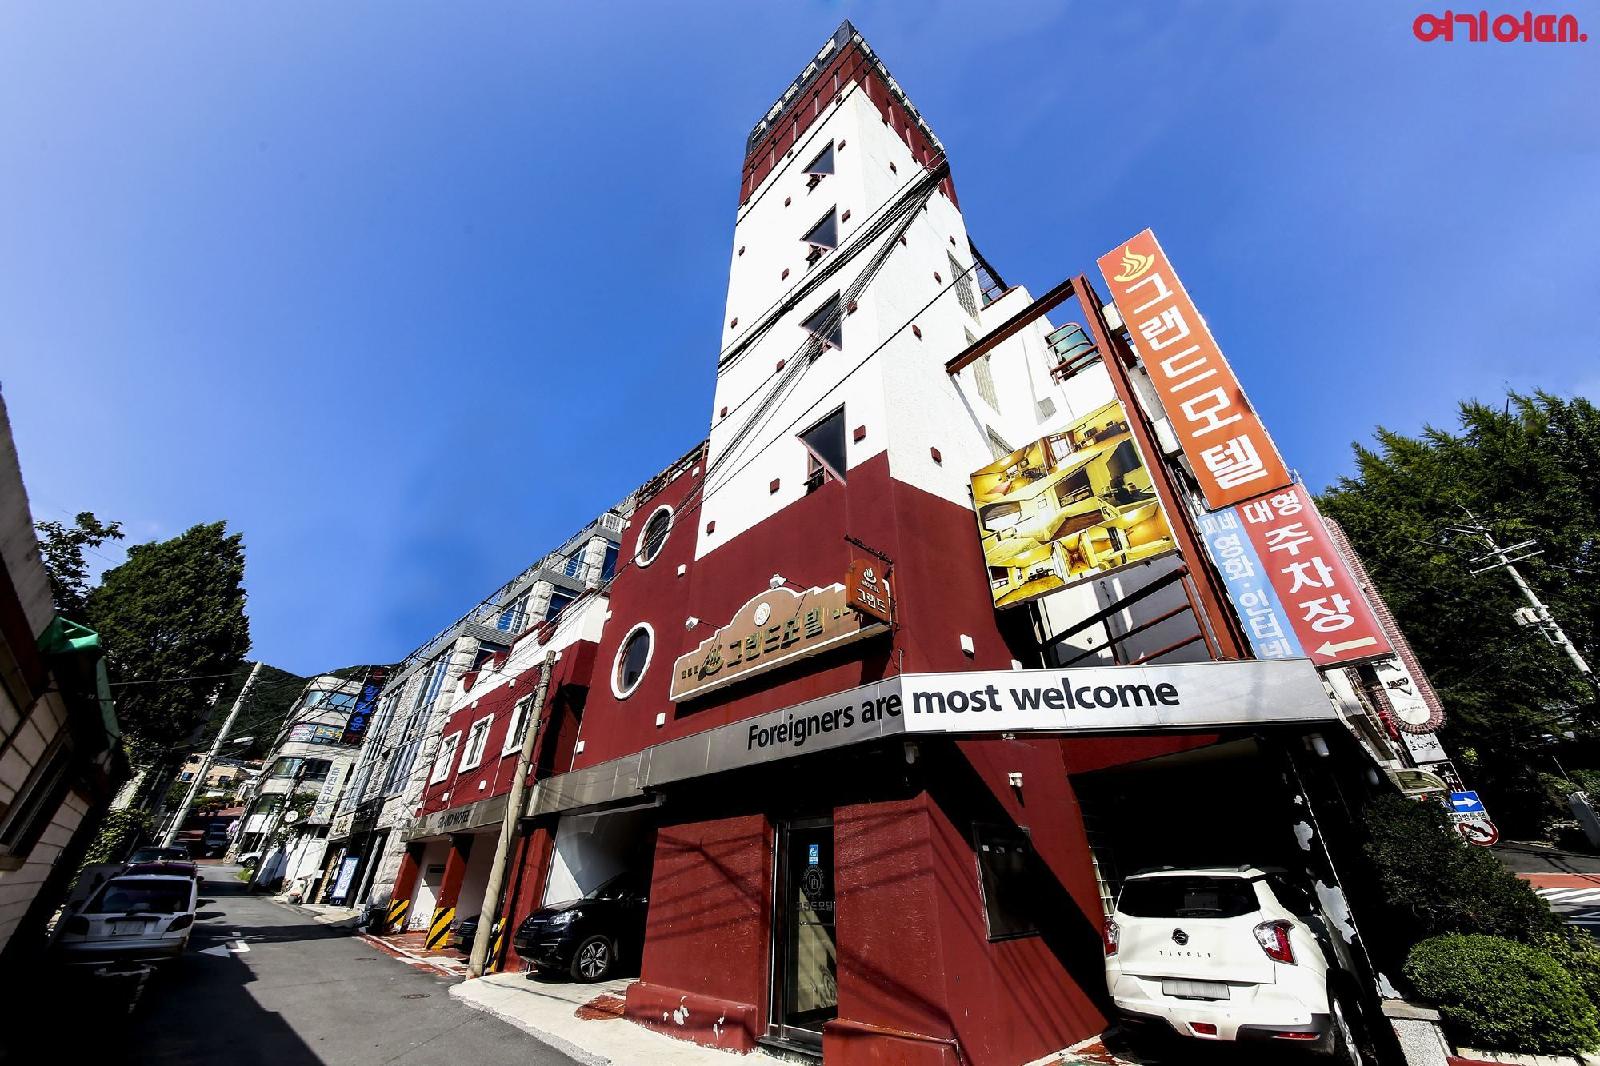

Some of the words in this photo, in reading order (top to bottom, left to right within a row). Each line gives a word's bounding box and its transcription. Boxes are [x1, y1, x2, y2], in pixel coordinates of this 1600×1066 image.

[1126, 272, 1268, 490] 그랜드모텔
[1242, 489, 1303, 524] 대형
[857, 587, 887, 614] 그랜드
[1264, 521, 1355, 633] 주차장
[748, 704, 855, 750] Foreigners
[861, 694, 902, 723] are
[913, 684, 1002, 714] most
[1010, 677, 1180, 710] welcome
